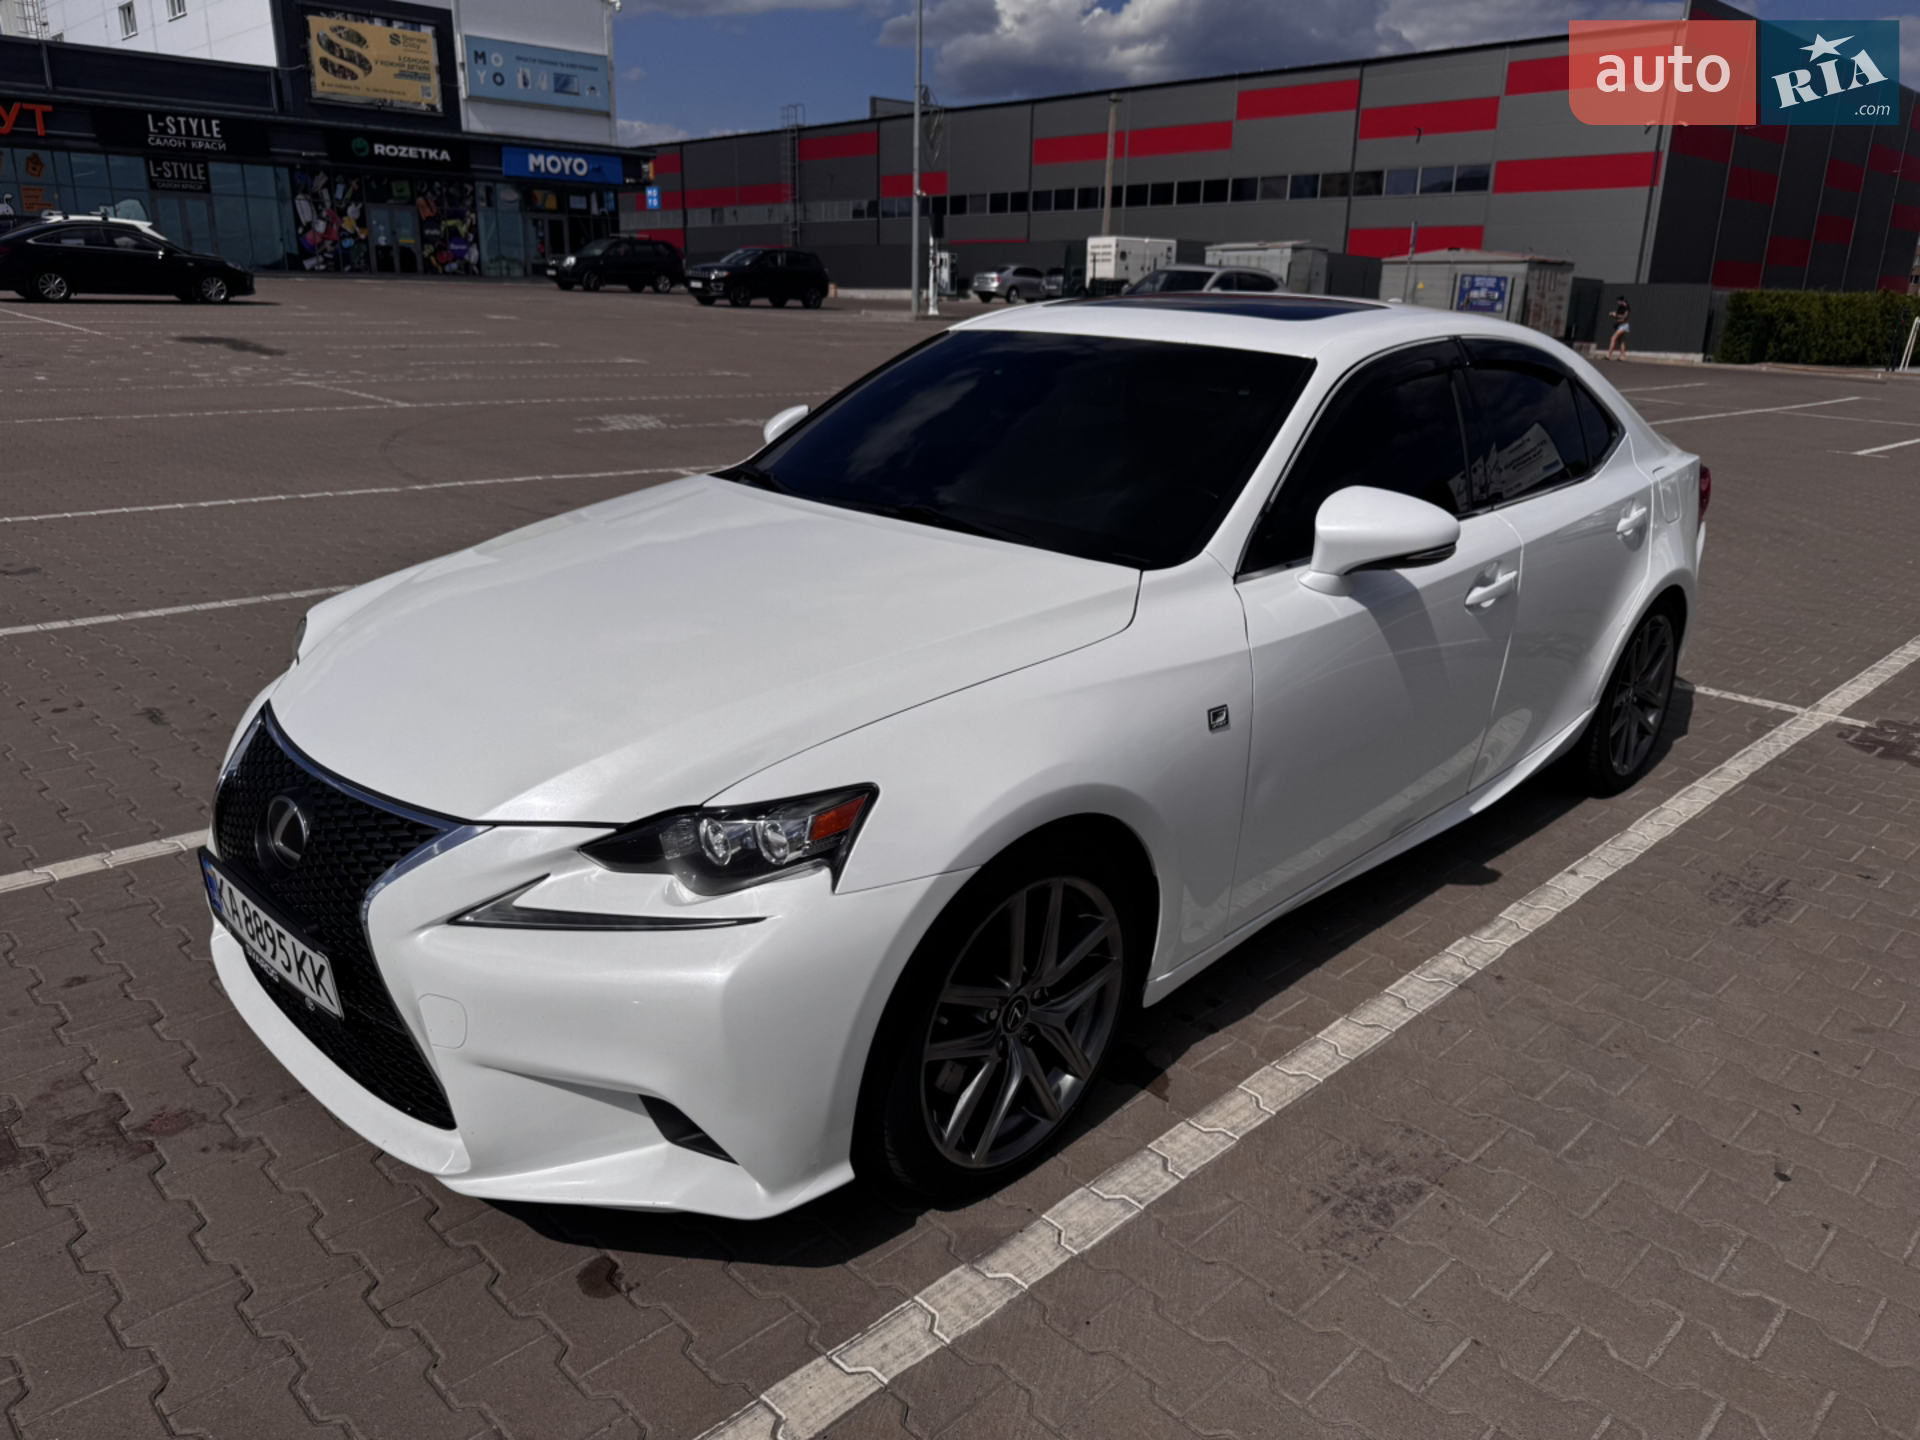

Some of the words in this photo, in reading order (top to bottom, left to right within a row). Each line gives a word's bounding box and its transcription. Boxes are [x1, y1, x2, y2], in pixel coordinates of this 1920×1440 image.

[147, 113, 222, 138] L-STYLE
[147, 136, 187, 148] САЛОН
[191, 140, 227, 151] КРАСИ
[373, 143, 452, 162] ROZETKA
[149, 160, 207, 180] L-STYLE
[528, 153, 588, 177] MOYO
